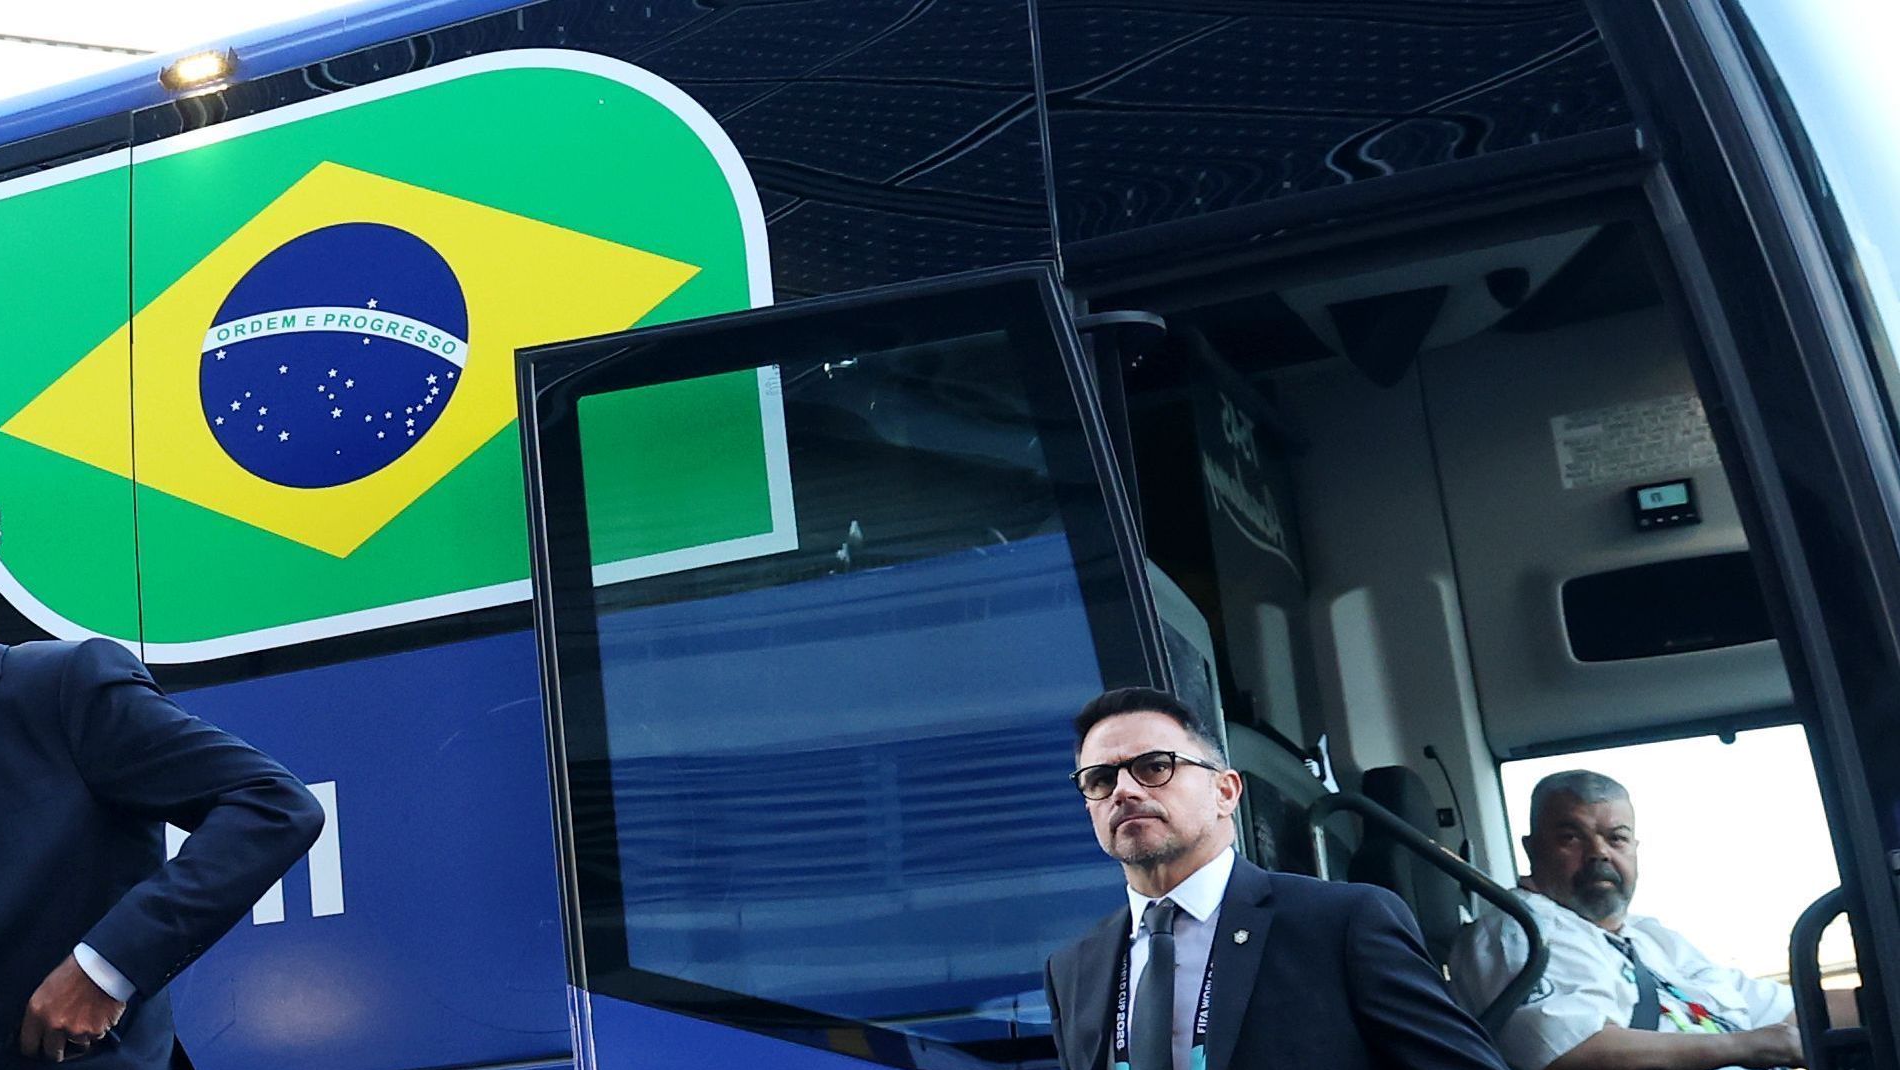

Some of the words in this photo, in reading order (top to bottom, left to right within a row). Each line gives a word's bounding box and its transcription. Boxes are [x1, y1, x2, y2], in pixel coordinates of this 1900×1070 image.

[216, 314, 297, 342] ORDEM
[305, 315, 316, 327] E
[323, 313, 457, 355] PROGRESSO
[1117, 991, 1127, 1011] CUP
[1116, 1012, 1126, 1051] 2026
[1196, 1009, 1209, 1034] FIFA
